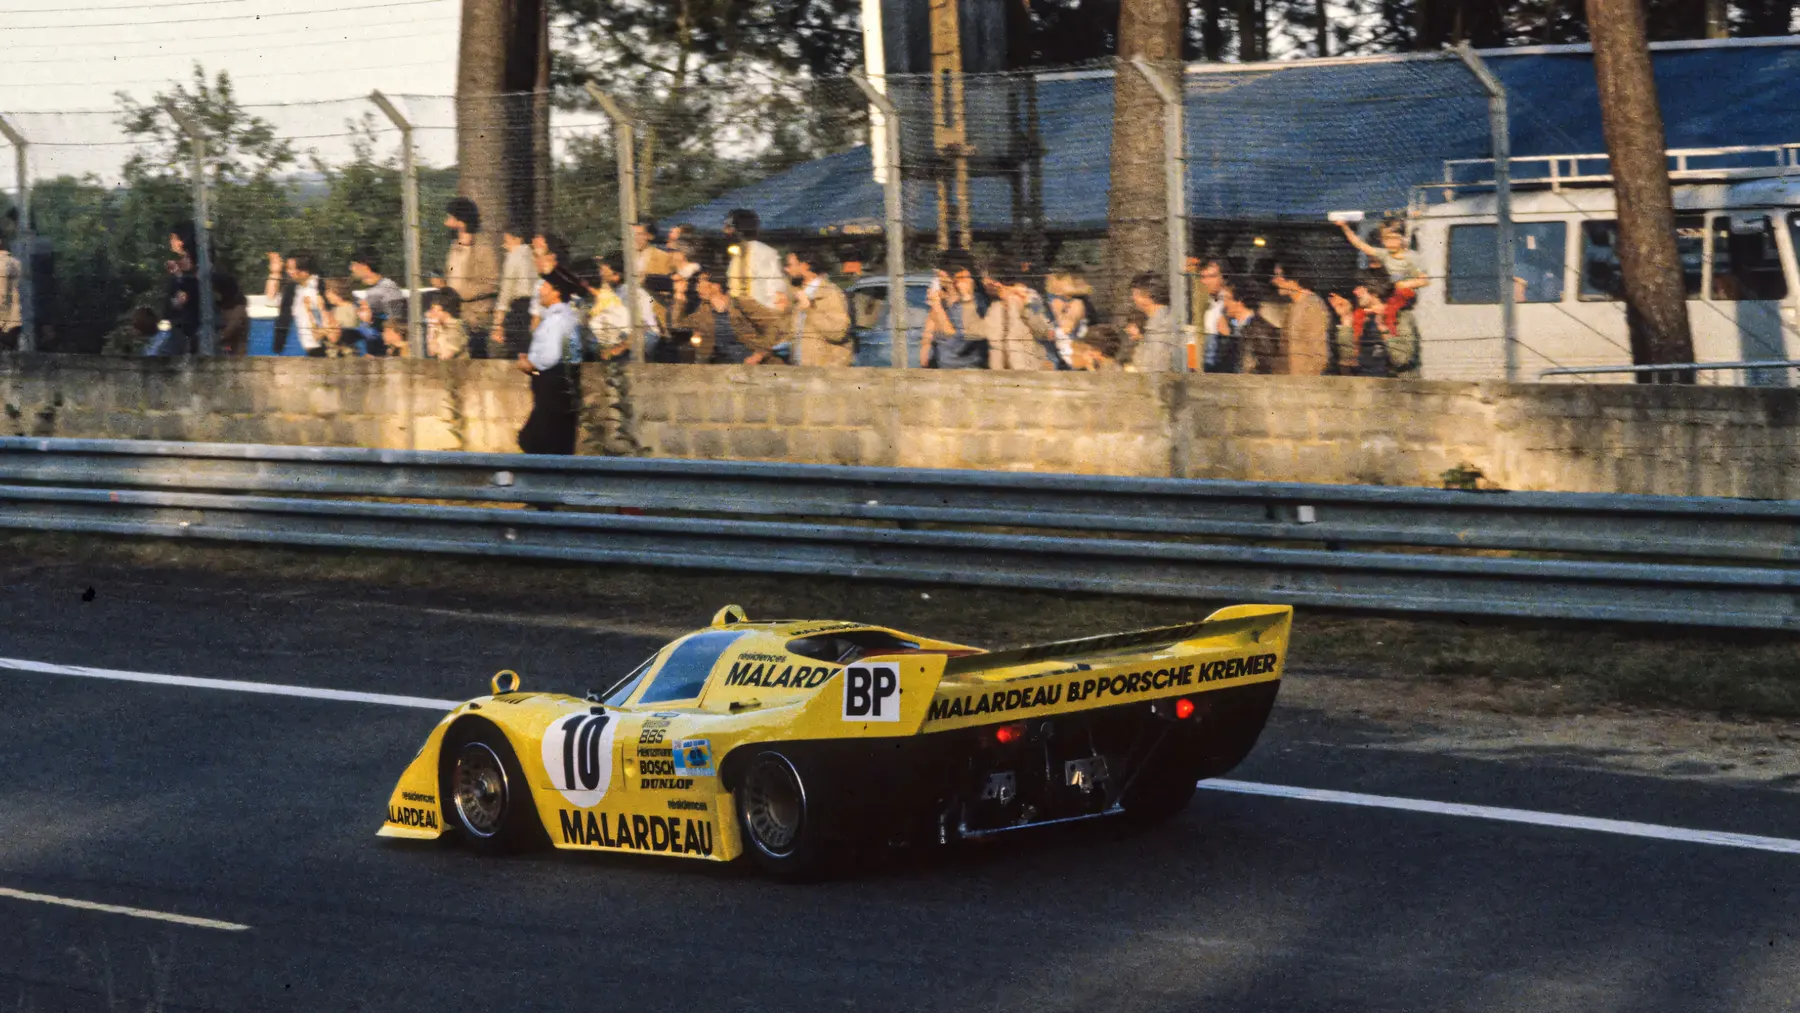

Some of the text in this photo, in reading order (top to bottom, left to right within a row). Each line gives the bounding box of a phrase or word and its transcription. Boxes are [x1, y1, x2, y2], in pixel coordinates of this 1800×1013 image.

[846, 667, 897, 717] BP
[928, 684, 1062, 721] MALARDEAU
[1096, 664, 1194, 698] PORSCHE
[1198, 653, 1277, 683] KREMER
[561, 715, 610, 790] 10
[639, 729, 667, 744] BBS
[640, 760, 675, 775] BOSCH
[641, 779, 694, 789] DUNLOP
[559, 809, 713, 857] MALARDEAU
